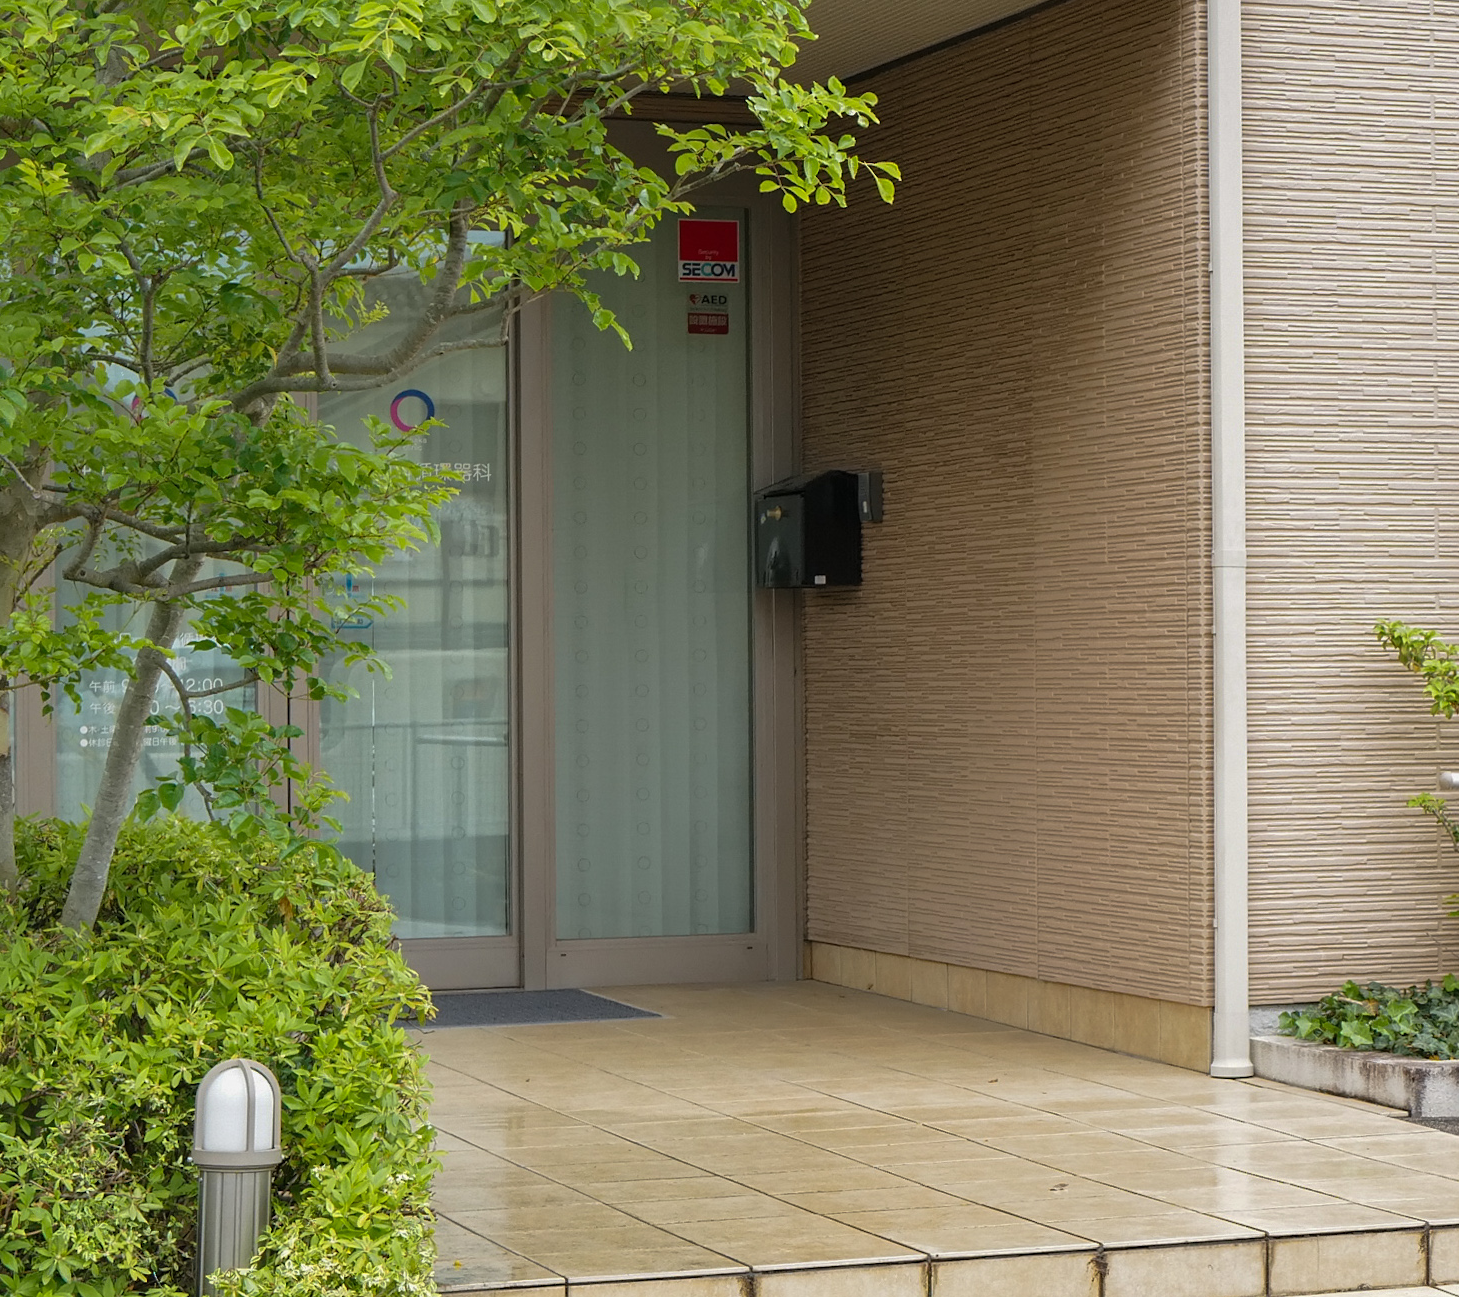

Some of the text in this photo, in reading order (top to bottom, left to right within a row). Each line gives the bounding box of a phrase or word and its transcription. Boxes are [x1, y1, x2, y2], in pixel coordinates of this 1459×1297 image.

[682, 262, 736, 277] SECOM
[701, 294, 727, 304] AED
[89, 680, 115, 694] 午前
[89, 702, 115, 715] 午後
